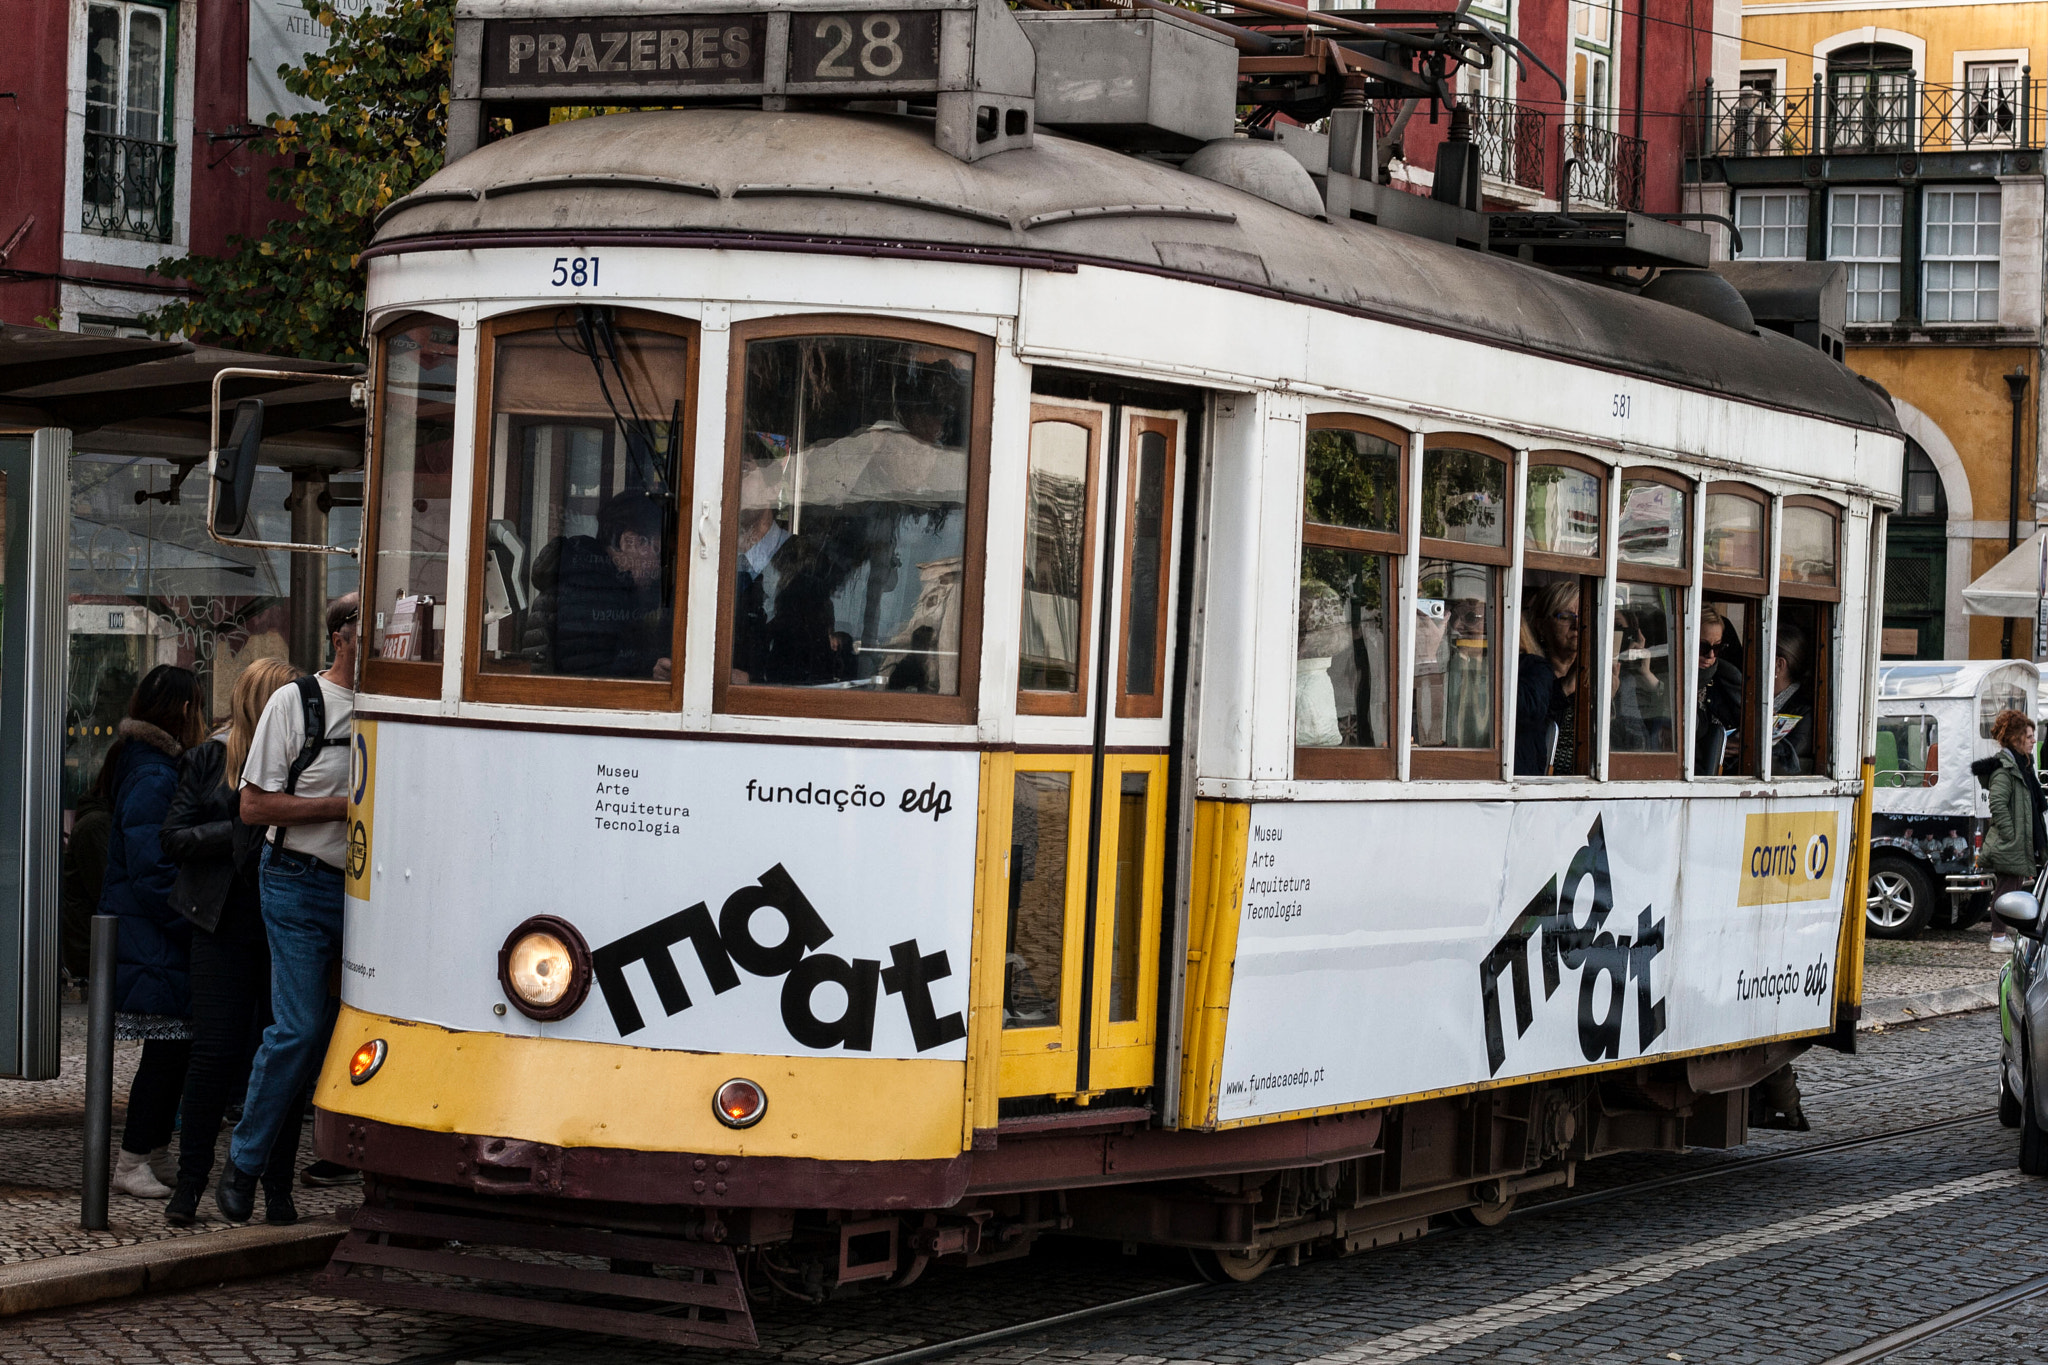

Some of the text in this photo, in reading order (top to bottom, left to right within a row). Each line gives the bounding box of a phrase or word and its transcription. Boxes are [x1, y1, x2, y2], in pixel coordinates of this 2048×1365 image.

[286, 15, 330, 38] ATELIE
[509, 27, 750, 74] PRAZERES
[815, 14, 904, 77] 28
[551, 256, 600, 287] 581
[1612, 393, 1631, 419] 581
[110, 613, 123, 628] 100
[597, 764, 639, 778] Museu
[596, 781, 630, 796] Arte
[595, 799, 690, 818] Arquitetura
[746, 779, 953, 822] fundação edp
[594, 816, 681, 837] Tecnologia
[1254, 824, 1283, 842] Museu
[1251, 850, 1275, 868] Arte
[1751, 831, 1797, 878] carris
[1249, 876, 1311, 898] Arquitetura
[1247, 900, 1302, 922] Tecnologia
[591, 862, 968, 1053] maat
[1736, 952, 1828, 1007] fundação edp
[1226, 1066, 1325, 1095] www.fundacaoedp.pt
